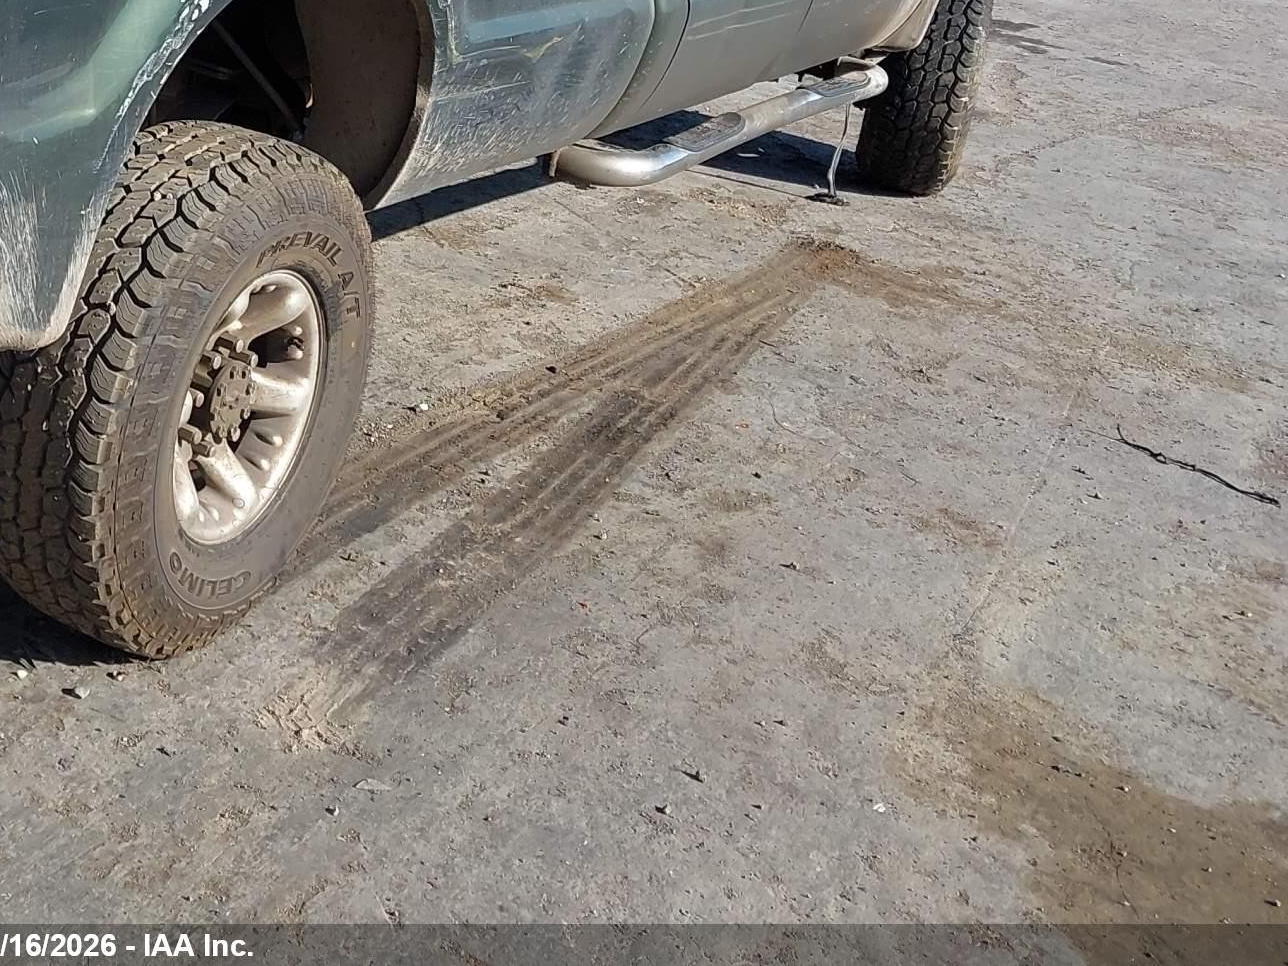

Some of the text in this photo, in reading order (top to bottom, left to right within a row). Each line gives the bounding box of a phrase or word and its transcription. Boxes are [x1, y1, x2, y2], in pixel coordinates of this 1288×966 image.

[255, 231, 362, 319] PREVAIL A/T
[169, 551, 252, 600] CELIMO
